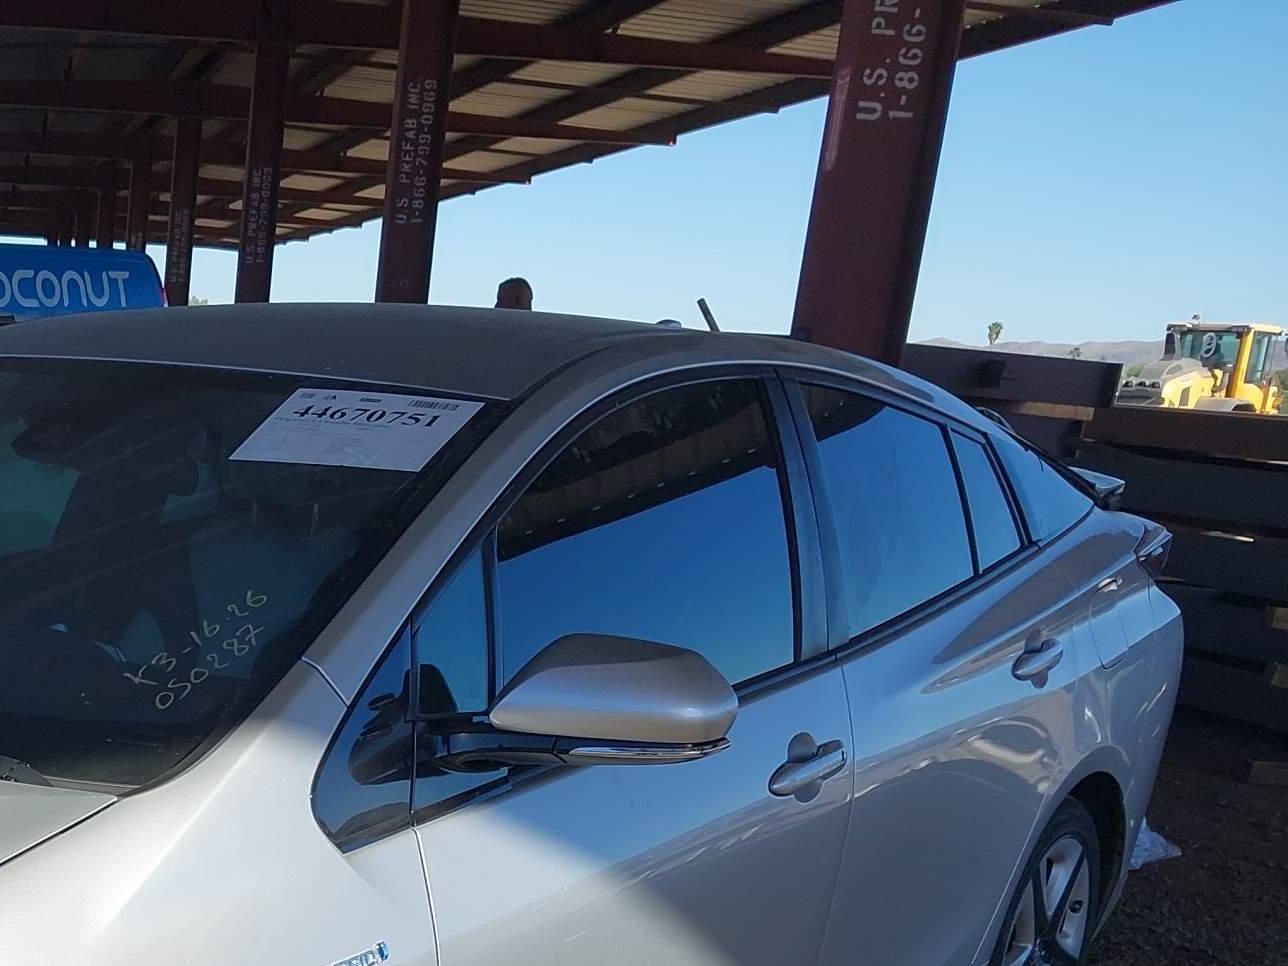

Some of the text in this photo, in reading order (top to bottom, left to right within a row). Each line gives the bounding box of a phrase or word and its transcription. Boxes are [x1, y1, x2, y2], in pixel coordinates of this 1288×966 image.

[855, 57, 891, 121] U.S.
[398, 118, 418, 184] PREFAB
[292, 404, 442, 430] 44670751
[155, 624, 265, 710] 050287
